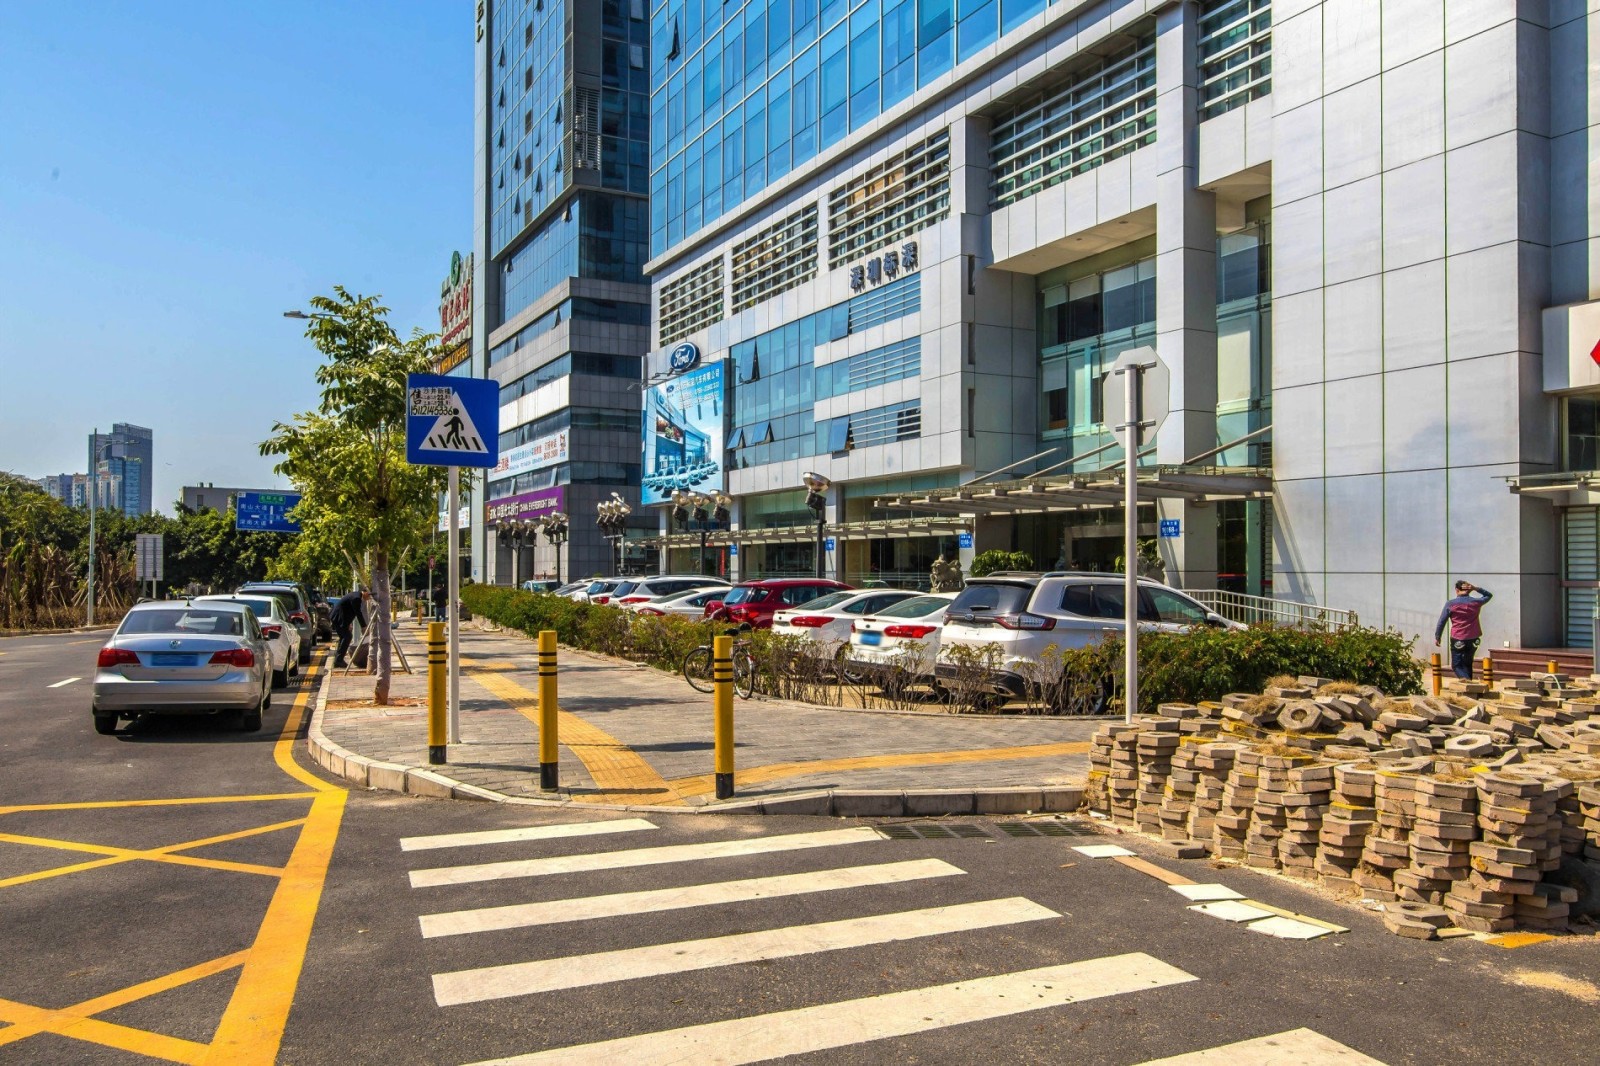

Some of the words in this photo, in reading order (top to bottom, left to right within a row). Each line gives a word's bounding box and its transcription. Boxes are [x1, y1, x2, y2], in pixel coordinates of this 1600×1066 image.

[849, 241, 918, 293] 深圳标深
[673, 347, 691, 367] Ford
[410, 388, 422, 404] 售
[240, 503, 267, 511] 南山大道
[548, 497, 558, 508] BANK
